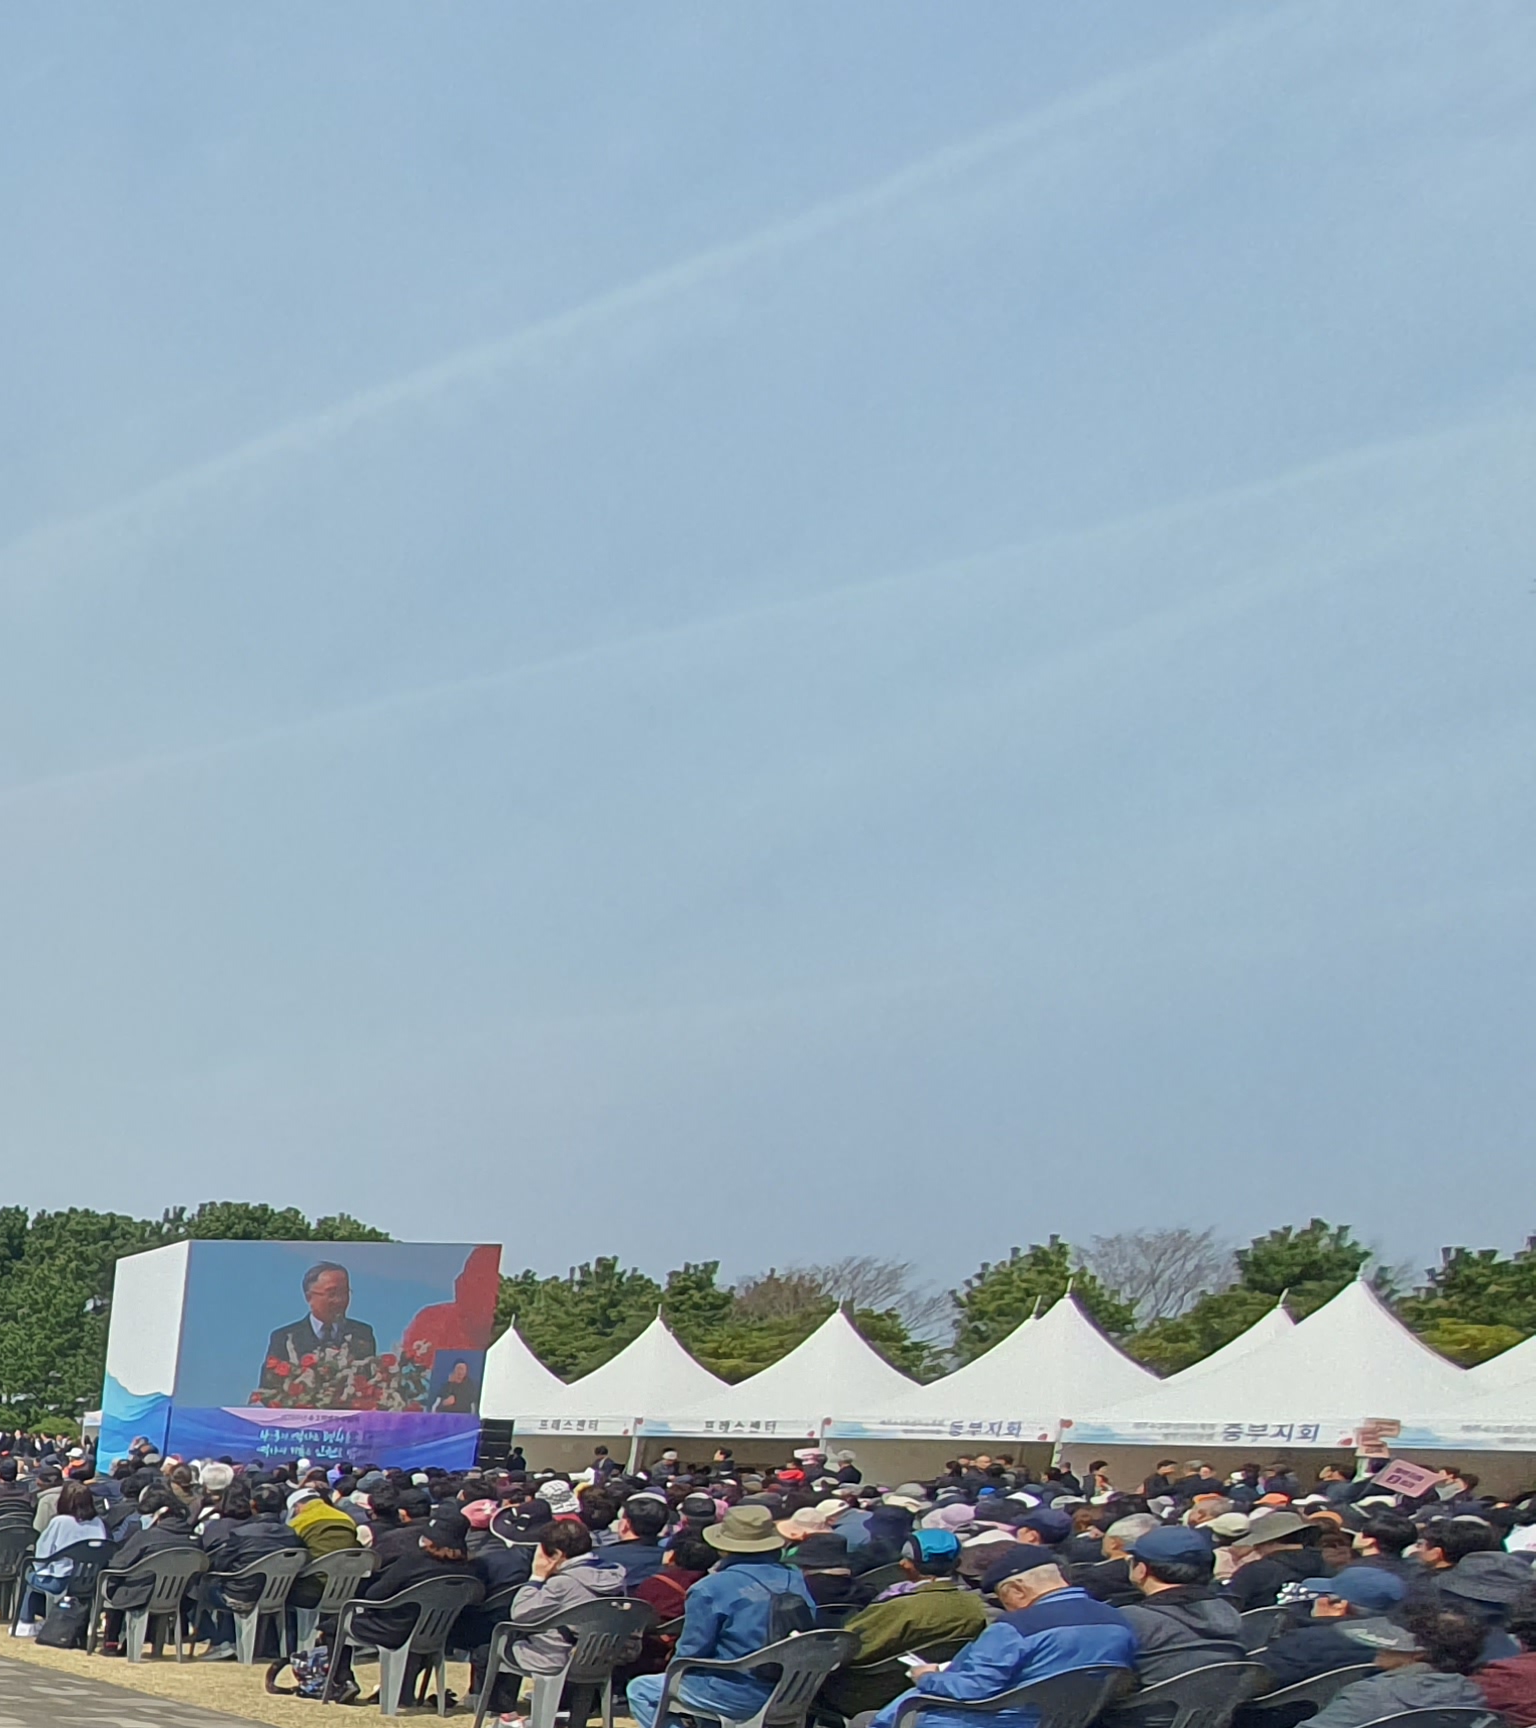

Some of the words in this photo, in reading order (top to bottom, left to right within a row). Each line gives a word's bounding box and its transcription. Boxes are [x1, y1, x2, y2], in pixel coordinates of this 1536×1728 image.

[538, 1418, 599, 1432] 프레스센터
[704, 1420, 777, 1434] 프레스센터
[949, 1420, 1022, 1437] 동부지회
[1223, 1423, 1320, 1443] 중부지회
